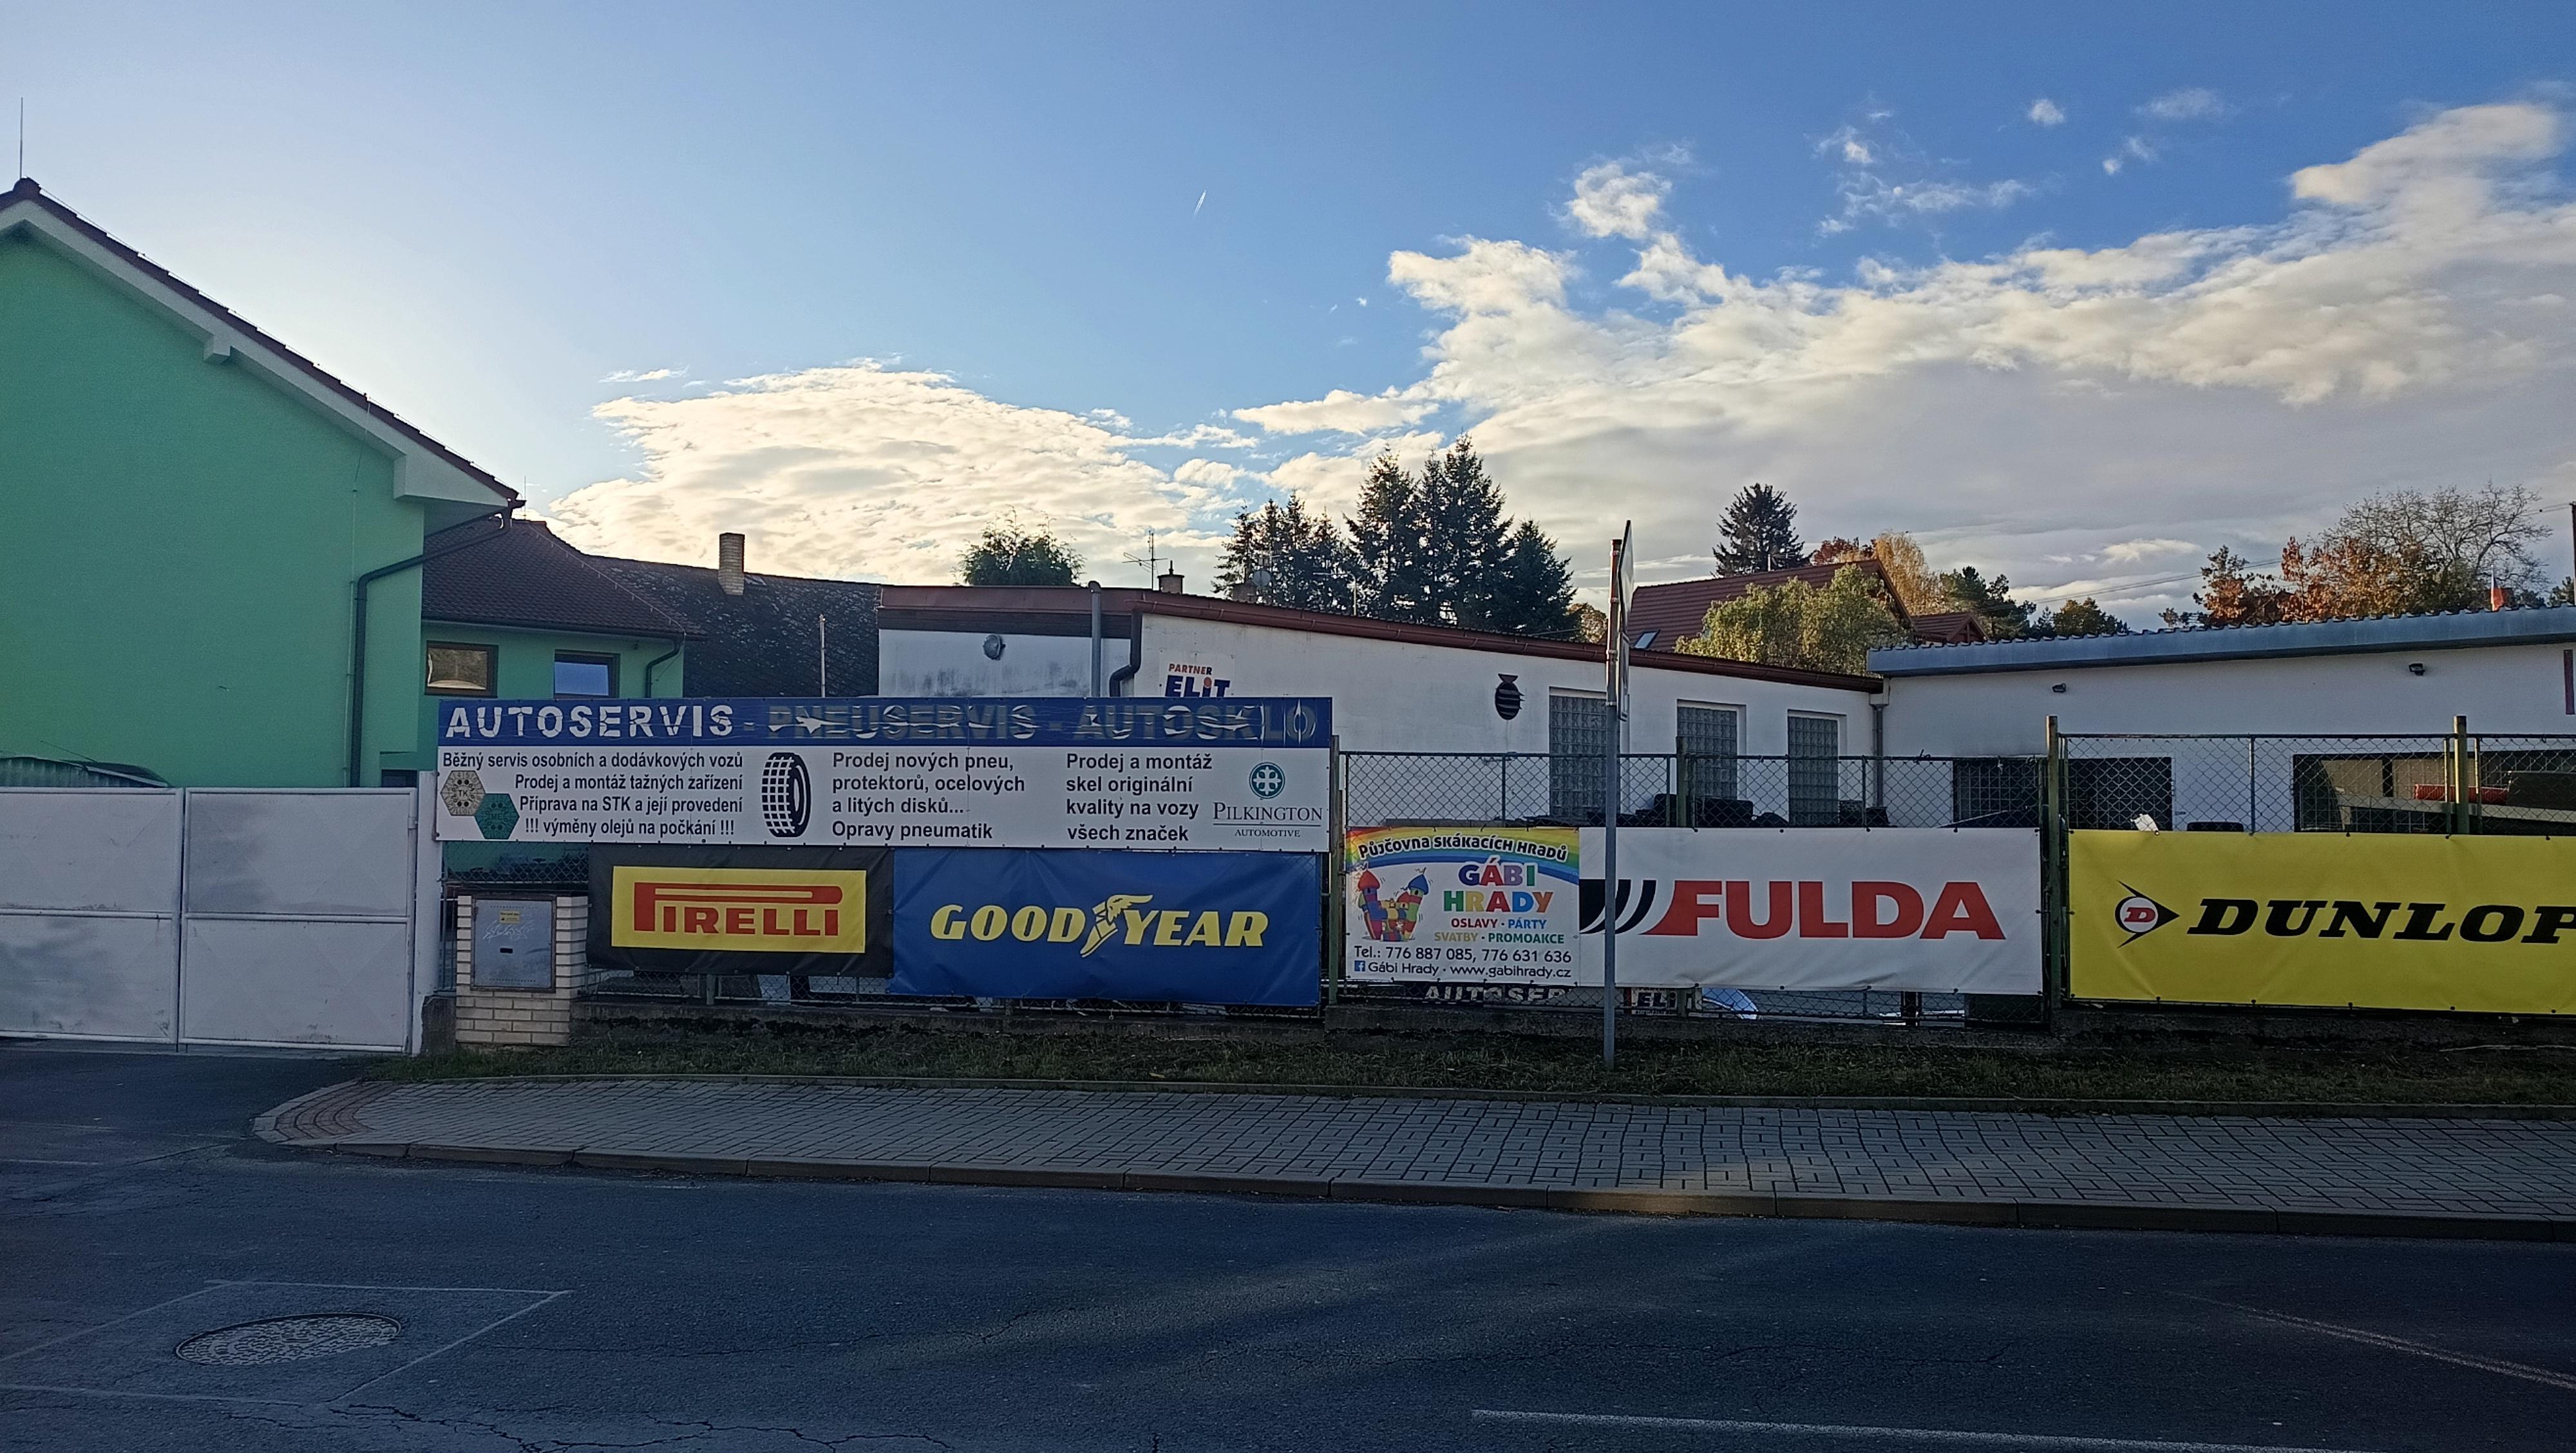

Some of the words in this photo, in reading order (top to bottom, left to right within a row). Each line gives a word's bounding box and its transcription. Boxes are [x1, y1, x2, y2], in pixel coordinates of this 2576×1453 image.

[1169, 663, 1213, 675] PARTNER
[446, 705, 734, 739] AUTOSERVIS
[768, 705, 1037, 739] PNEUSERVIS
[1074, 705, 1317, 740] AUTOSKLO
[443, 752, 483, 770] Běžný
[488, 752, 527, 767] servis
[532, 752, 594, 767] osobních
[599, 755, 607, 767] a
[612, 752, 705, 771] dodávkových
[710, 752, 743, 767] vozů
[833, 752, 889, 772] Prodej
[896, 752, 958, 772] nových
[965, 756, 1014, 772] pneu,
[1066, 753, 1123, 773] Prodej
[1130, 757, 1140, 769] a
[1146, 754, 1213, 770] montáž
[515, 774, 558, 792] Prodej
[563, 778, 571, 788] a
[575, 774, 626, 789] montáž
[630, 774, 683, 793] tažných
[688, 774, 743, 790] zařízení
[833, 774, 929, 793] protektorů,
[935, 775, 1025, 795] ocelových
[1066, 776, 1102, 792] skel
[1108, 777, 1192, 795] originální
[520, 795, 577, 814] Příprava
[582, 799, 598, 811] na
[602, 796, 630, 811] STK
[635, 800, 643, 811] a
[645, 796, 667, 815] její
[672, 797, 743, 815] provedení
[833, 801, 842, 813] a
[848, 797, 894, 817] litých
[901, 797, 963, 813] disků...
[1066, 799, 1123, 819] kvality
[1130, 803, 1151, 815] na
[1157, 803, 1198, 819] vozy
[1213, 802, 1323, 821] PILKINGTON
[526, 818, 538, 833] !!!
[544, 818, 596, 837] výměny
[601, 818, 634, 837] olejů
[639, 822, 655, 835] na
[660, 819, 715, 837] počkání
[721, 820, 734, 835] !!!
[832, 821, 894, 840] Opravy
[901, 824, 992, 840] pneumatik
[1068, 824, 1119, 840] všech
[1126, 825, 1189, 841] značek
[1235, 829, 1300, 837] AUTOMOTIVE
[1459, 857, 1536, 886] GÁBI
[634, 882, 842, 936] PIRELLI
[1444, 891, 1553, 913] HRADY
[1638, 880, 2006, 940] FULDA
[1452, 918, 1498, 928] OSLAVY
[1508, 917, 1547, 929] PÁRTY
[2124, 907, 2155, 922] D
[2186, 898, 2576, 944] DUNLOP
[1434, 932, 1478, 942] SVATBY
[1488, 933, 1564, 944] PROMOAKCE
[1354, 945, 1381, 958] Tel.:
[1386, 947, 1411, 959] 776
[1416, 947, 1441, 960] 887
[1446, 948, 1477, 963] 085,
[1482, 949, 1508, 961] 776
[1513, 949, 1537, 962] 631
[1544, 951, 1571, 963] 636
[1368, 962, 1397, 973] Gábi
[1402, 963, 1439, 976] Hrady
[1450, 965, 1571, 979] www.gabihrady.cz
